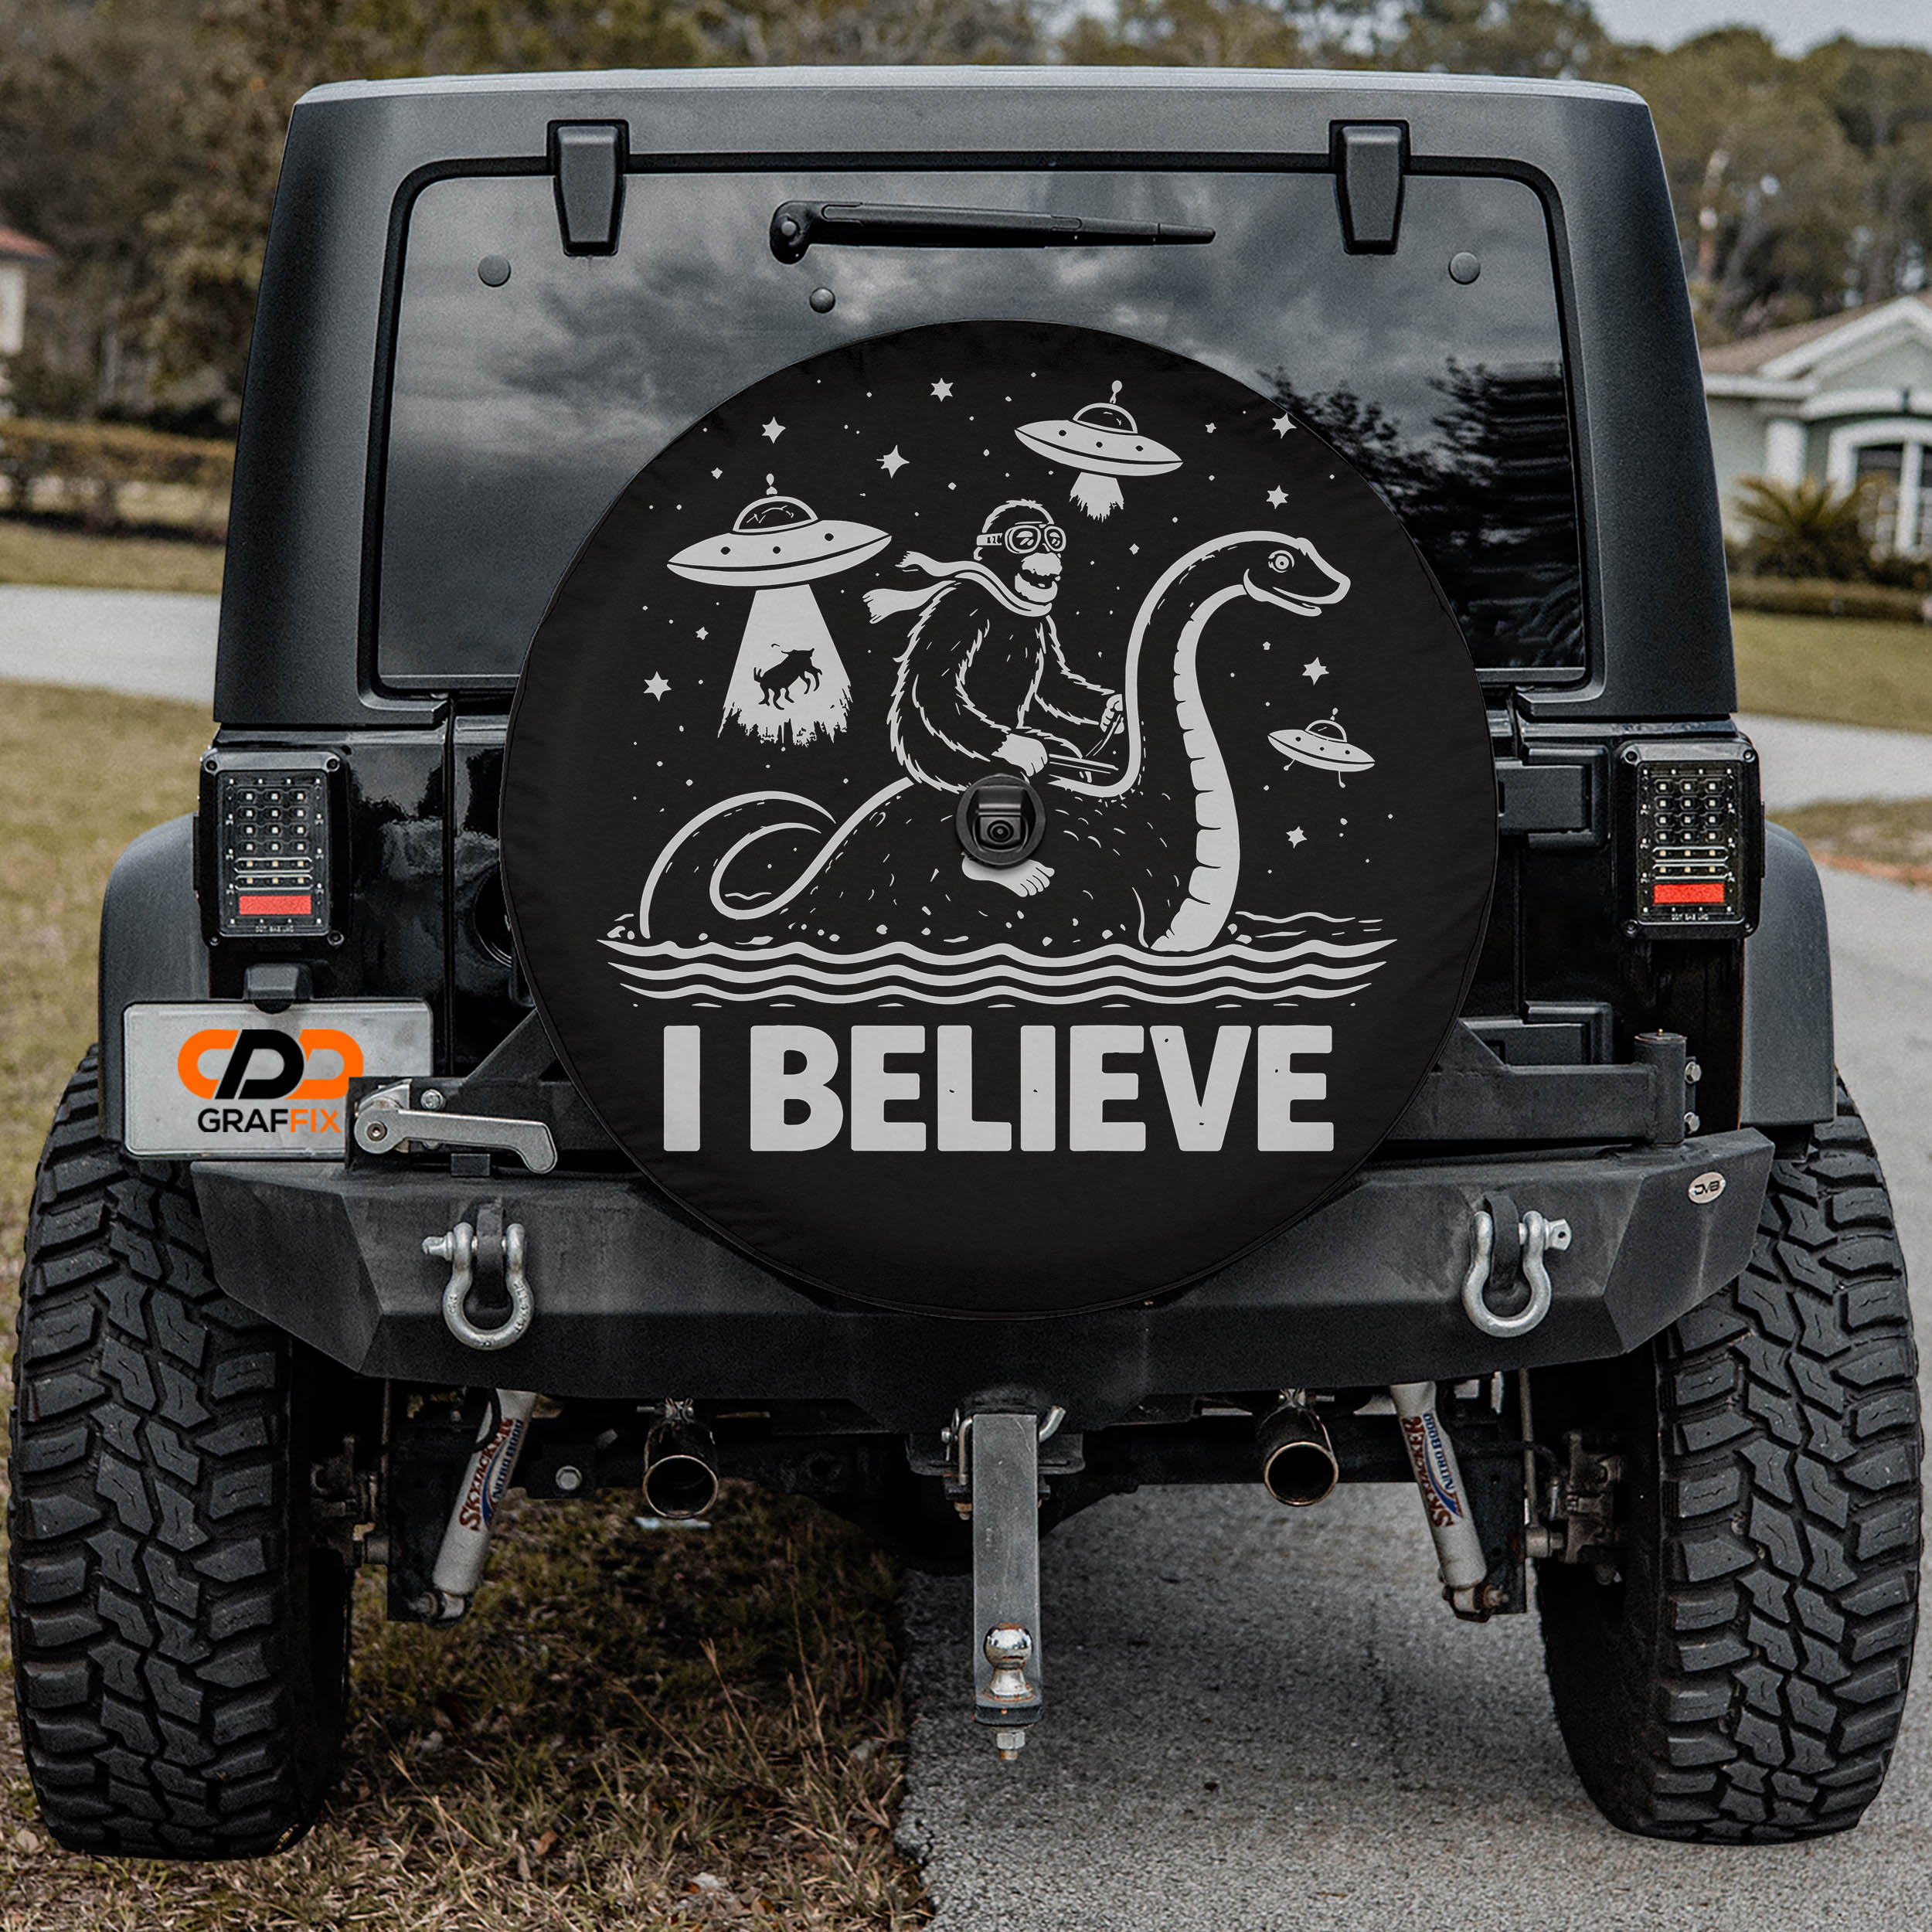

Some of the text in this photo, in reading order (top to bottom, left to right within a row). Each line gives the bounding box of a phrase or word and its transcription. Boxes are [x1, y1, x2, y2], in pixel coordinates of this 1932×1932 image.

[198, 1108, 340, 1133] GRAFFIX
[663, 1025, 1335, 1151] I BELIEVE
[1402, 1416, 1454, 1528] SKYJACKER
[1423, 1413, 1456, 1490] NITRO 8000
